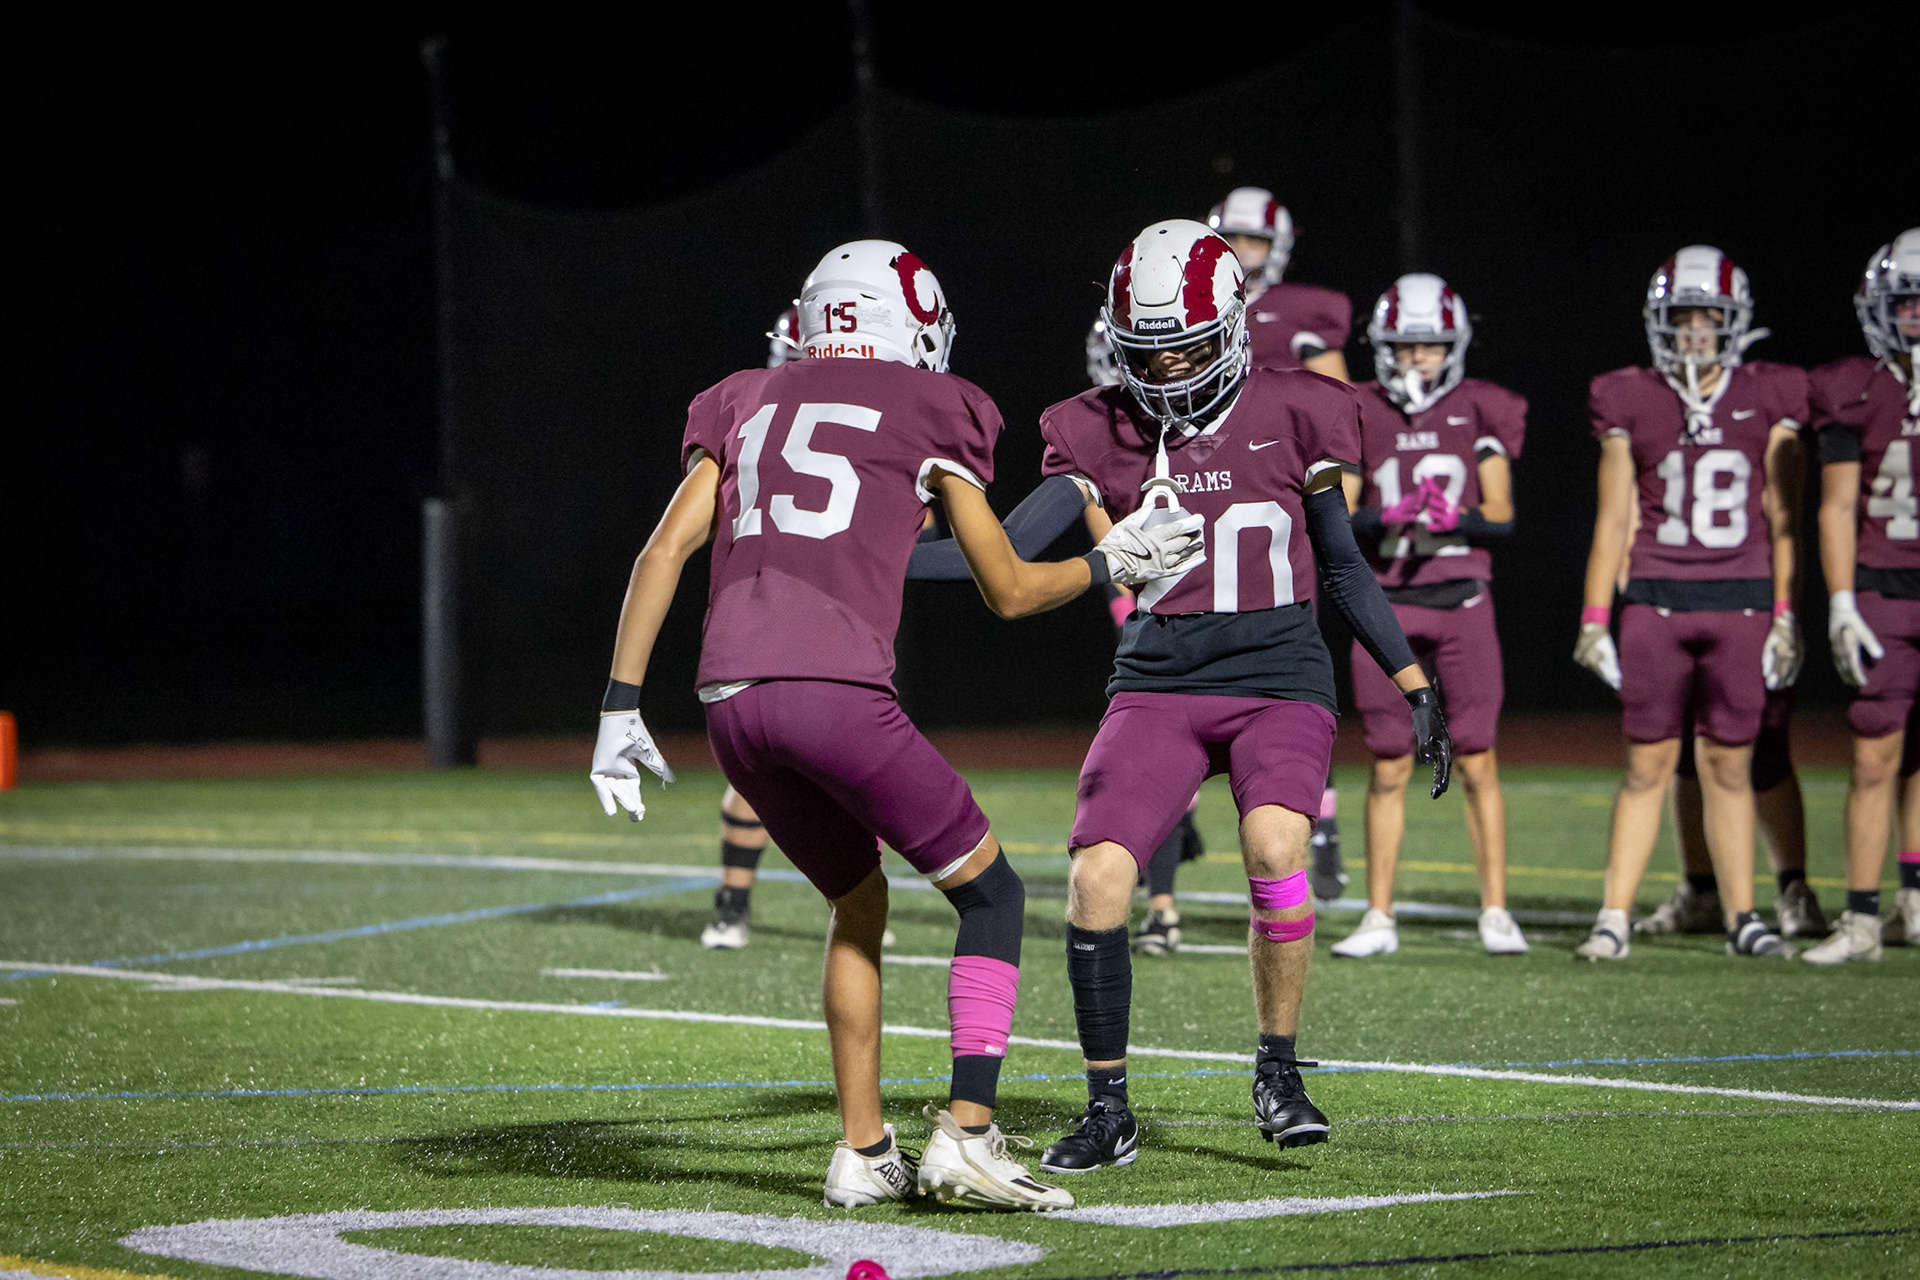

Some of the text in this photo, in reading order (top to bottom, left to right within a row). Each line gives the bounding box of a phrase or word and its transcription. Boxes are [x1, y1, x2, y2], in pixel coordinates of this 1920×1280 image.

[824, 302, 857, 333] 15
[1138, 319, 1176, 329] Riddell
[732, 403, 883, 539] 15
[1174, 471, 1232, 493] RAMS
[1656, 449, 1750, 549] 18
[1867, 440, 1919, 540] 4
